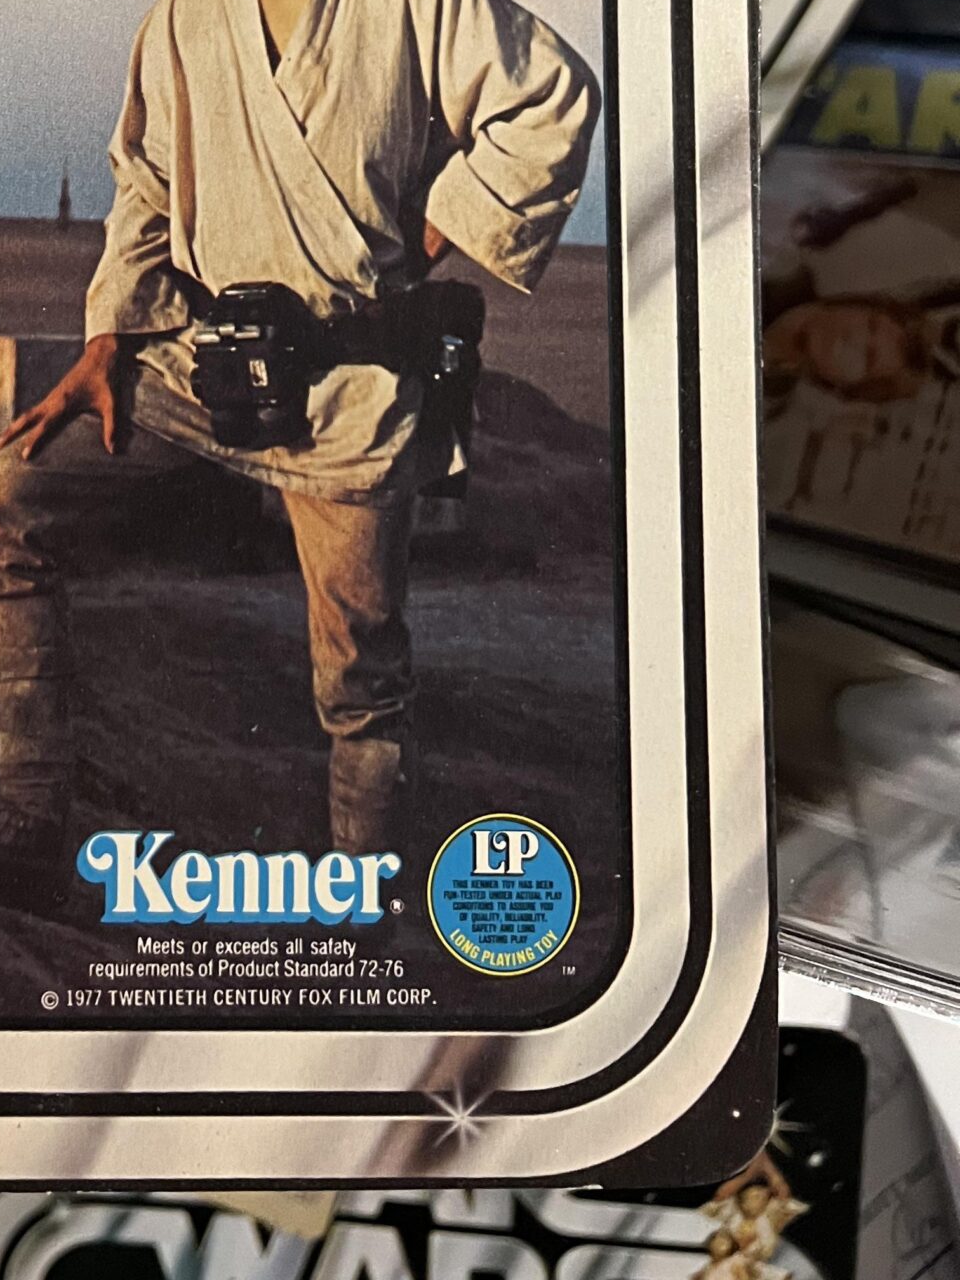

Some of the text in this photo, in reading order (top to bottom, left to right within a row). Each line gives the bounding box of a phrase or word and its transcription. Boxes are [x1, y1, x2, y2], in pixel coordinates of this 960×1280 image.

[471, 829, 539, 876] LP
[80, 831, 402, 921] Kenner
[137, 936, 357, 958] Meets or exceeds all safety
[450, 928, 559, 966] LONG PLAYING TOY
[89, 959, 405, 980] requirements of Product Standard 72-76
[67, 990, 102, 1007] 1977
[108, 989, 208, 1007] TWENTIETH
[213, 989, 293, 1006] CENTURY
[299, 989, 332, 1006] FOX
[339, 989, 381, 1006] FILM
[386, 988, 438, 1006] CORP.
